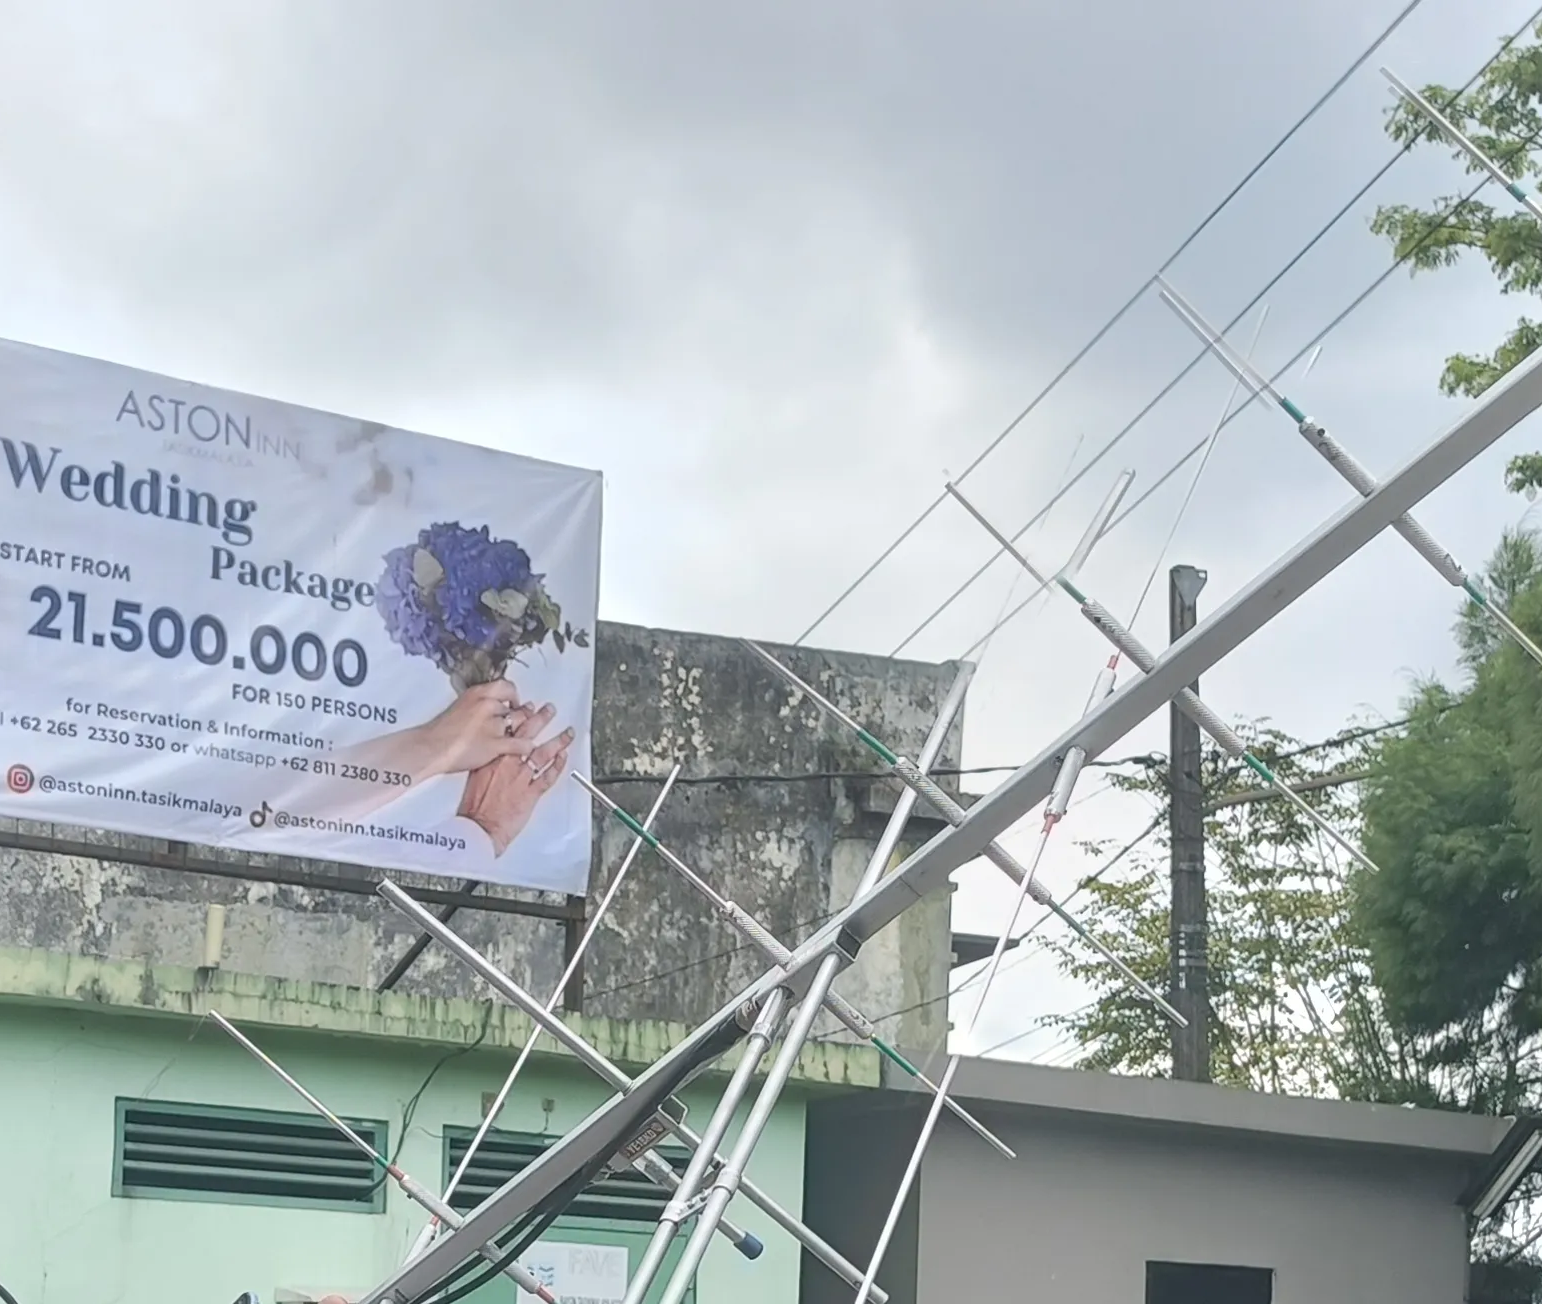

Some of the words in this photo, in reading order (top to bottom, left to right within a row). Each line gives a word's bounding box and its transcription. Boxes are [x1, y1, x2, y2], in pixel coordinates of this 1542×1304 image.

[116, 389, 251, 449] ASTON
[257, 430, 301, 460] INN
[0, 542, 65, 569] START
[71, 555, 130, 582] FROM
[210, 545, 375, 612] Package
[28, 585, 368, 687] 21.500.000
[66, 698, 90, 715] for
[97, 703, 201, 733] Reservation
[207, 719, 219, 734] &
[224, 722, 323, 750] Information
[232, 684, 270, 705] FOR
[276, 692, 306, 710] 150
[311, 696, 397, 724] PERSONS
[10, 716, 42, 732] +62
[47, 720, 78, 738] 265
[88, 727, 129, 745] 2330
[134, 734, 165, 752] 330
[171, 740, 189, 754] or
[194, 743, 276, 768] whatsapp
[281, 756, 309, 772] +62
[313, 761, 336, 776] 811
[341, 764, 379, 782] 2380
[383, 770, 412, 788] 330
[39, 775, 243, 817] @astoninn.tasikmalaya
[274, 811, 466, 850] @astoninn.tasikmalaya
